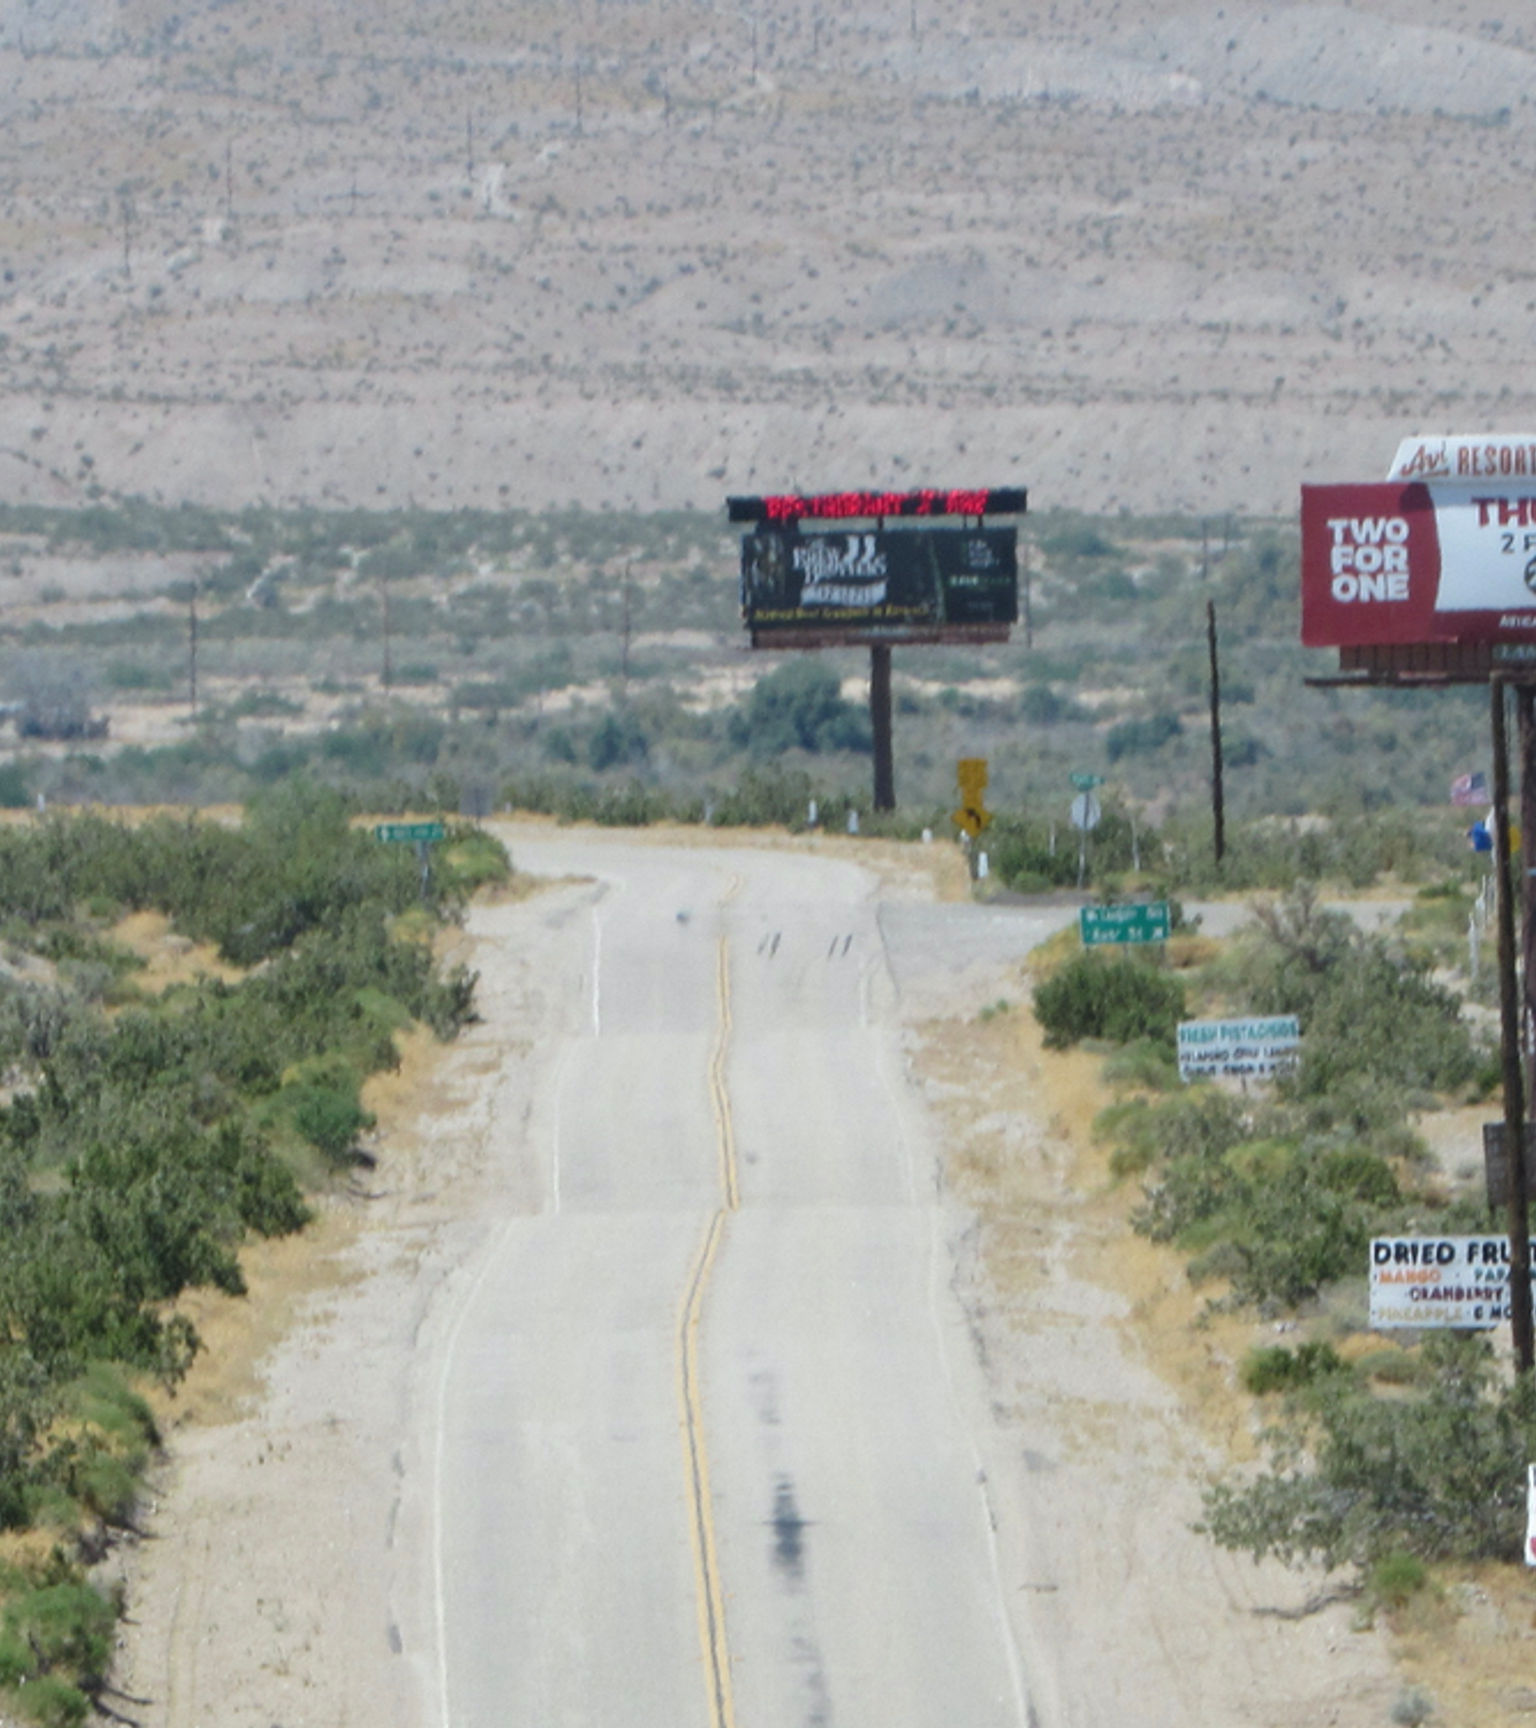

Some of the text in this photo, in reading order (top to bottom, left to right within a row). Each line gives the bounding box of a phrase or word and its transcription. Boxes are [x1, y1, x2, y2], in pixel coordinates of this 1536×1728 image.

[1327, 517, 1409, 544] TWO
[1501, 533, 1515, 553] 2
[1330, 545, 1409, 574] FOR
[1331, 573, 1410, 603] ONE
[1374, 1241, 1456, 1265] DRIED
[1379, 1268, 1442, 1284] MANGO
[1410, 1285, 1504, 1302] CRANBERRY
